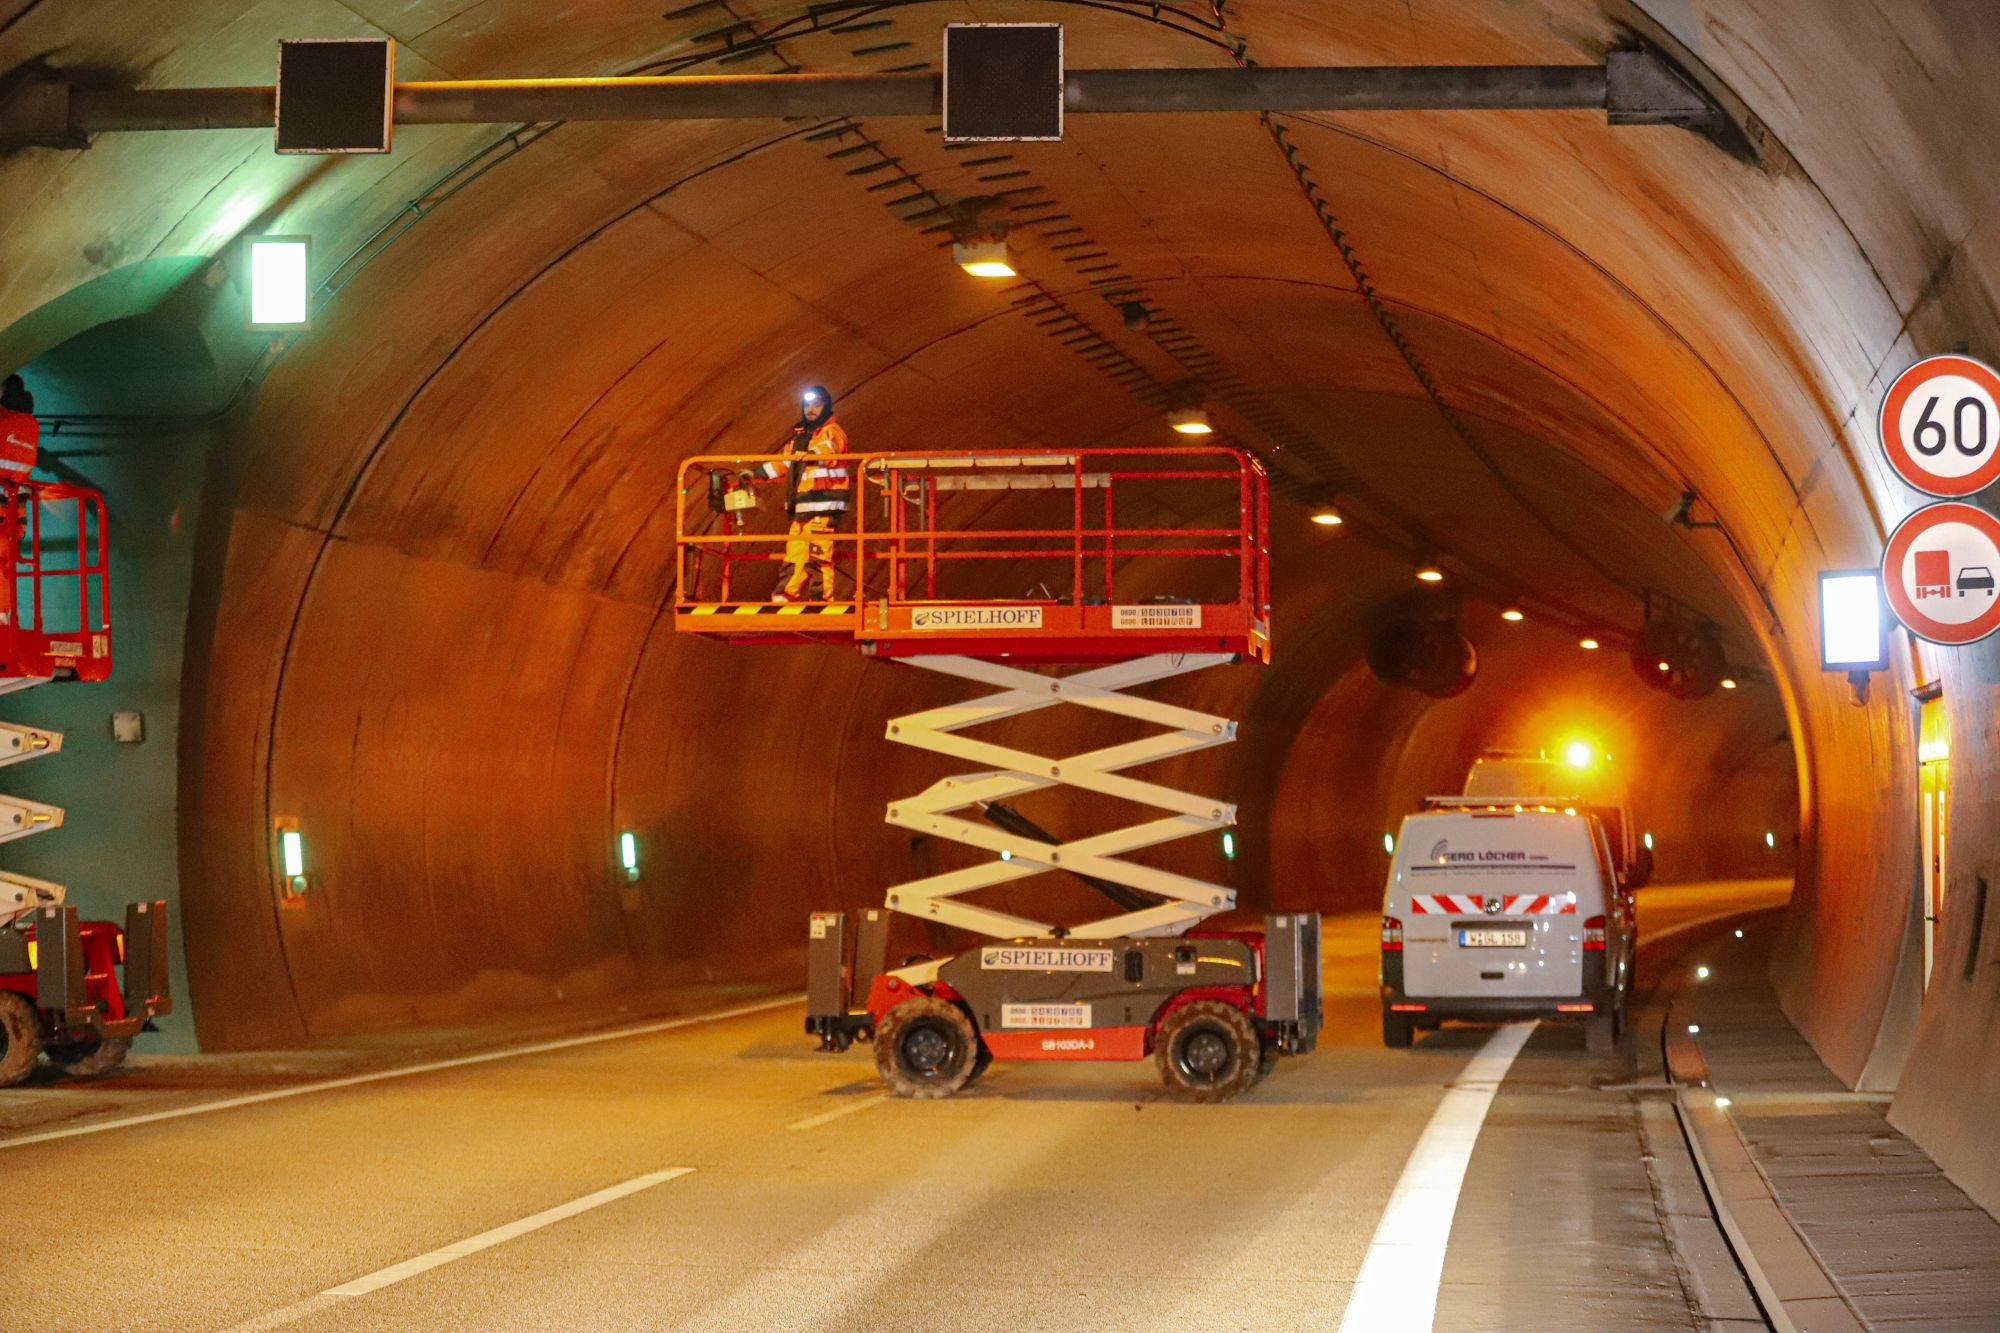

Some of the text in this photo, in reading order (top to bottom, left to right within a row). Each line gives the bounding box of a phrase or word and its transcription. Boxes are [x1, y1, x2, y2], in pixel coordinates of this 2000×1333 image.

[1913, 396, 1987, 456] 60
[931, 609, 1040, 624] SPIELHOFF
[1478, 851, 1525, 861] LÖCHER
[1000, 951, 1112, 966] SPIELHOFF
